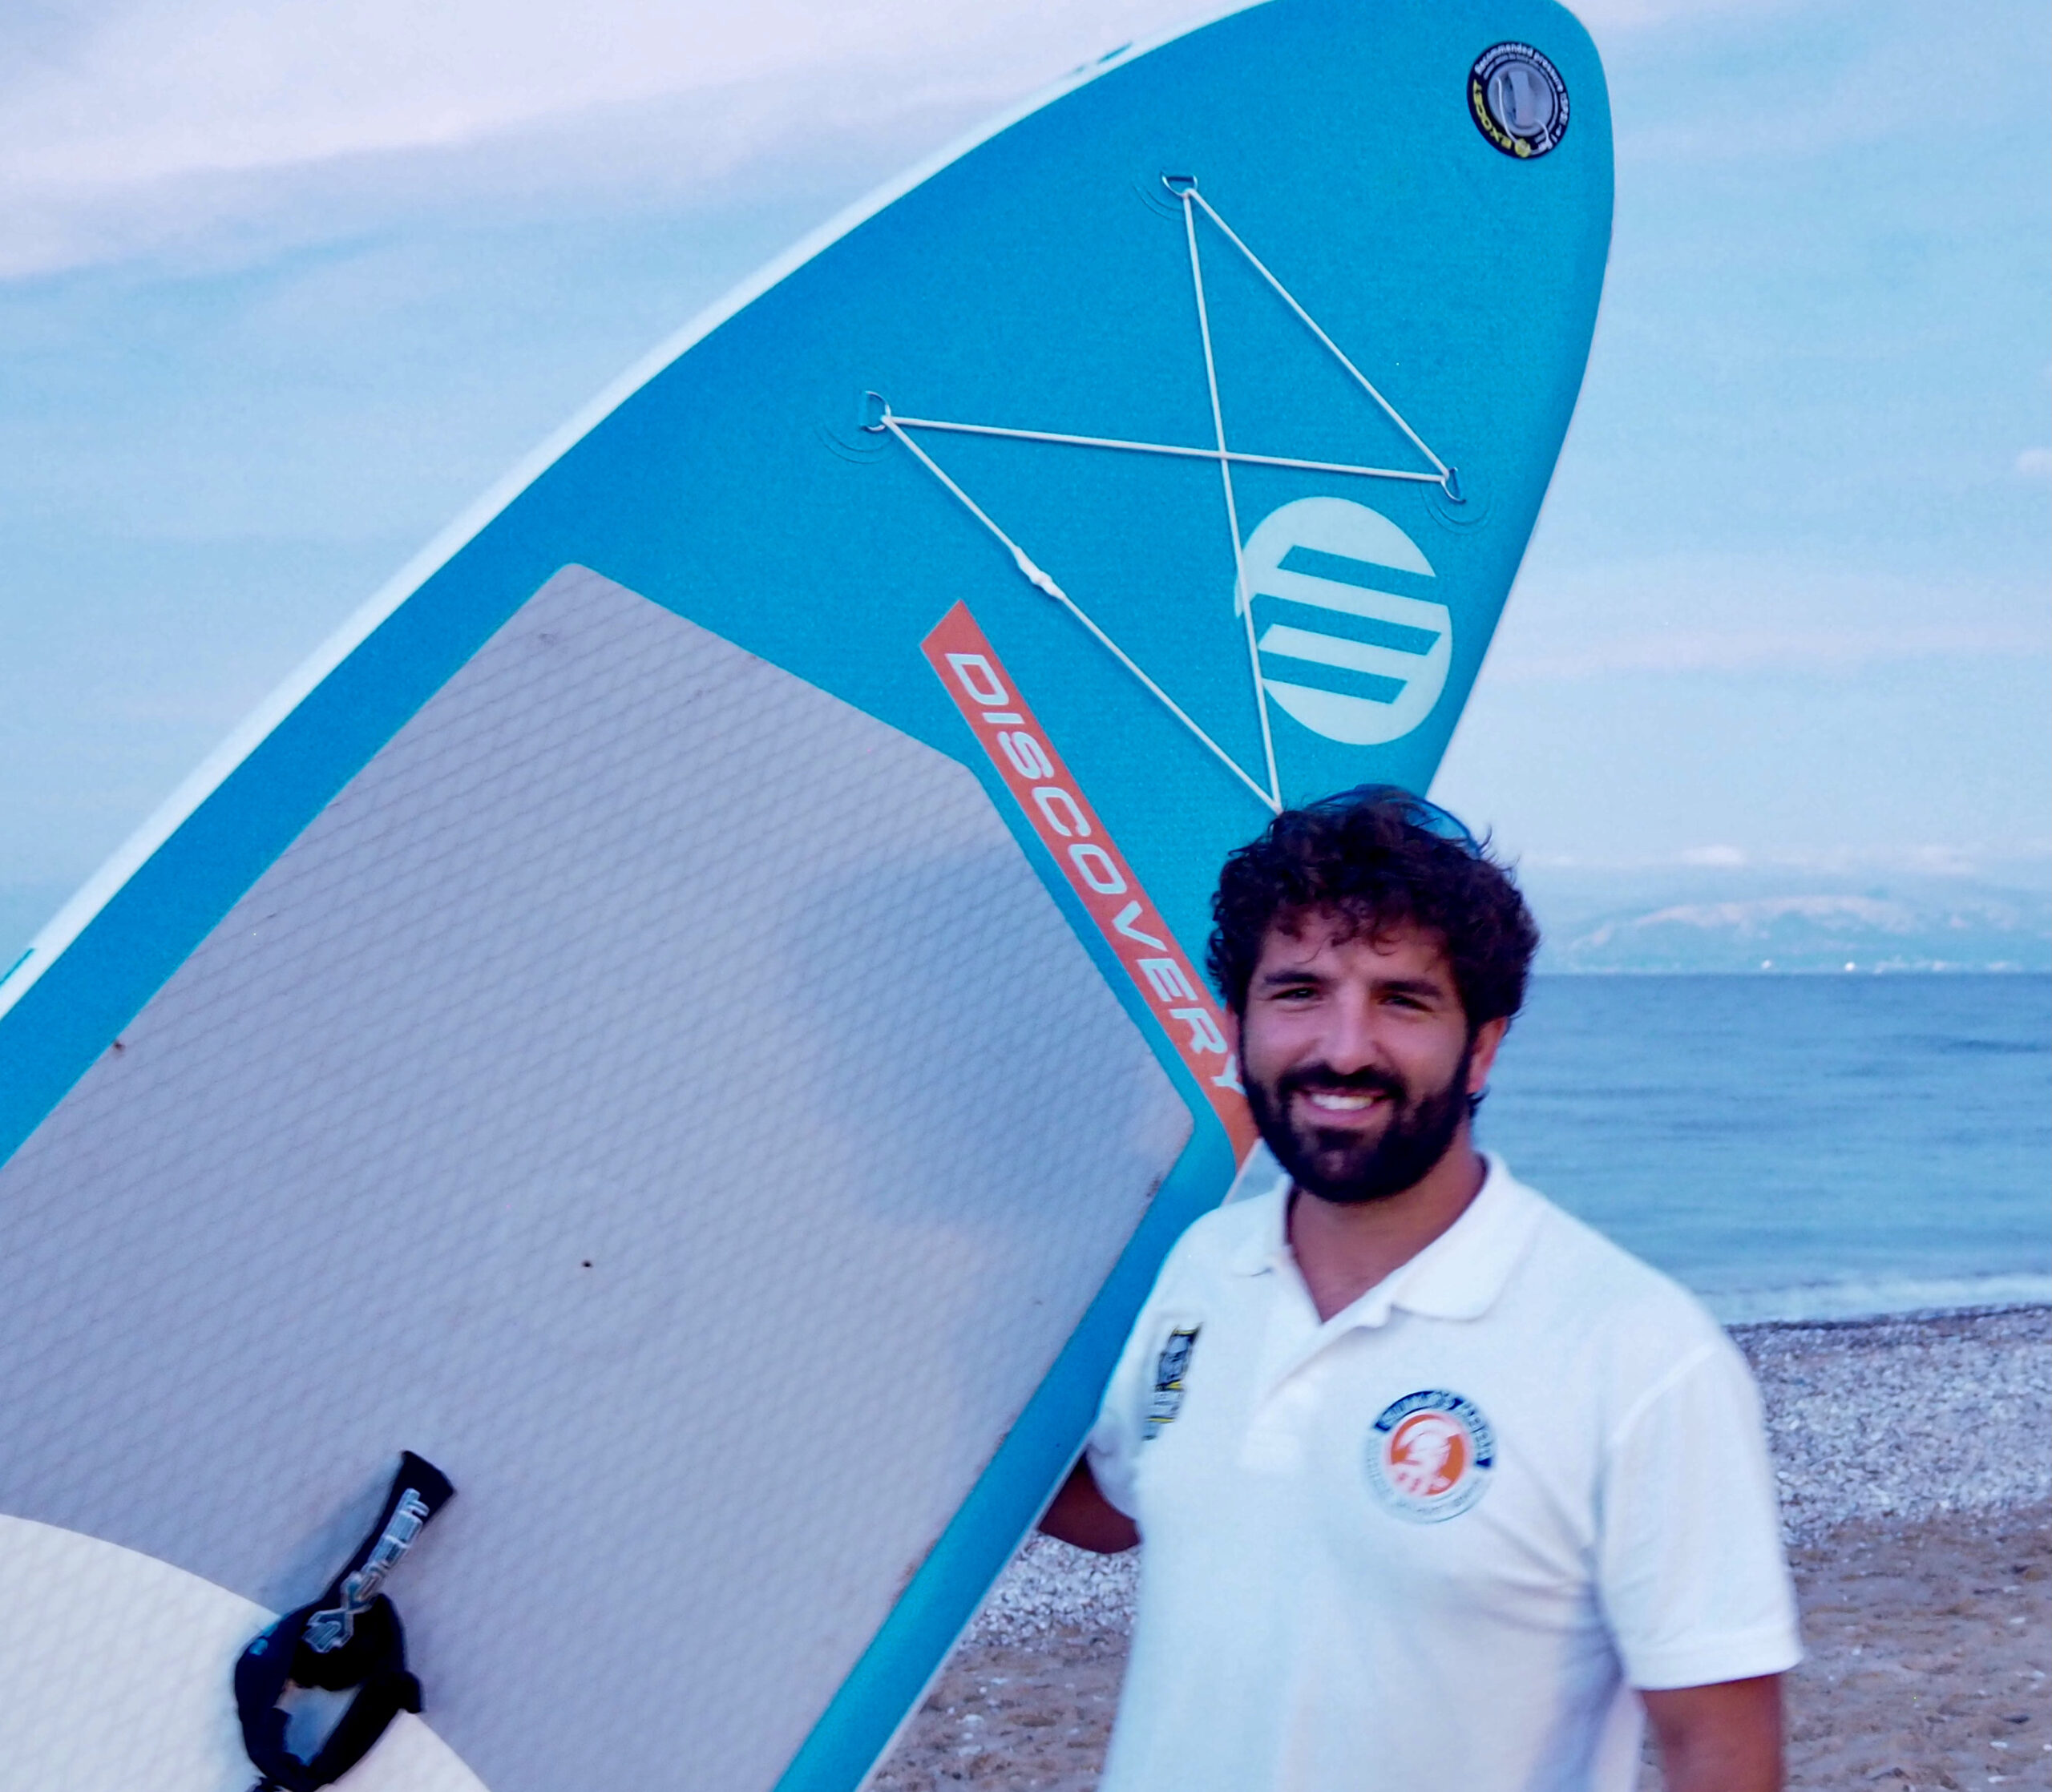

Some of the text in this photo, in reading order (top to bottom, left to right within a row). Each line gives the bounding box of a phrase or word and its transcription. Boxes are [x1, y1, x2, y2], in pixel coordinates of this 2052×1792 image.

[1474, 42, 1534, 75] Recommended
[1472, 79, 1513, 150] EXOCET
[945, 652, 1248, 1097] DISCOVERY
